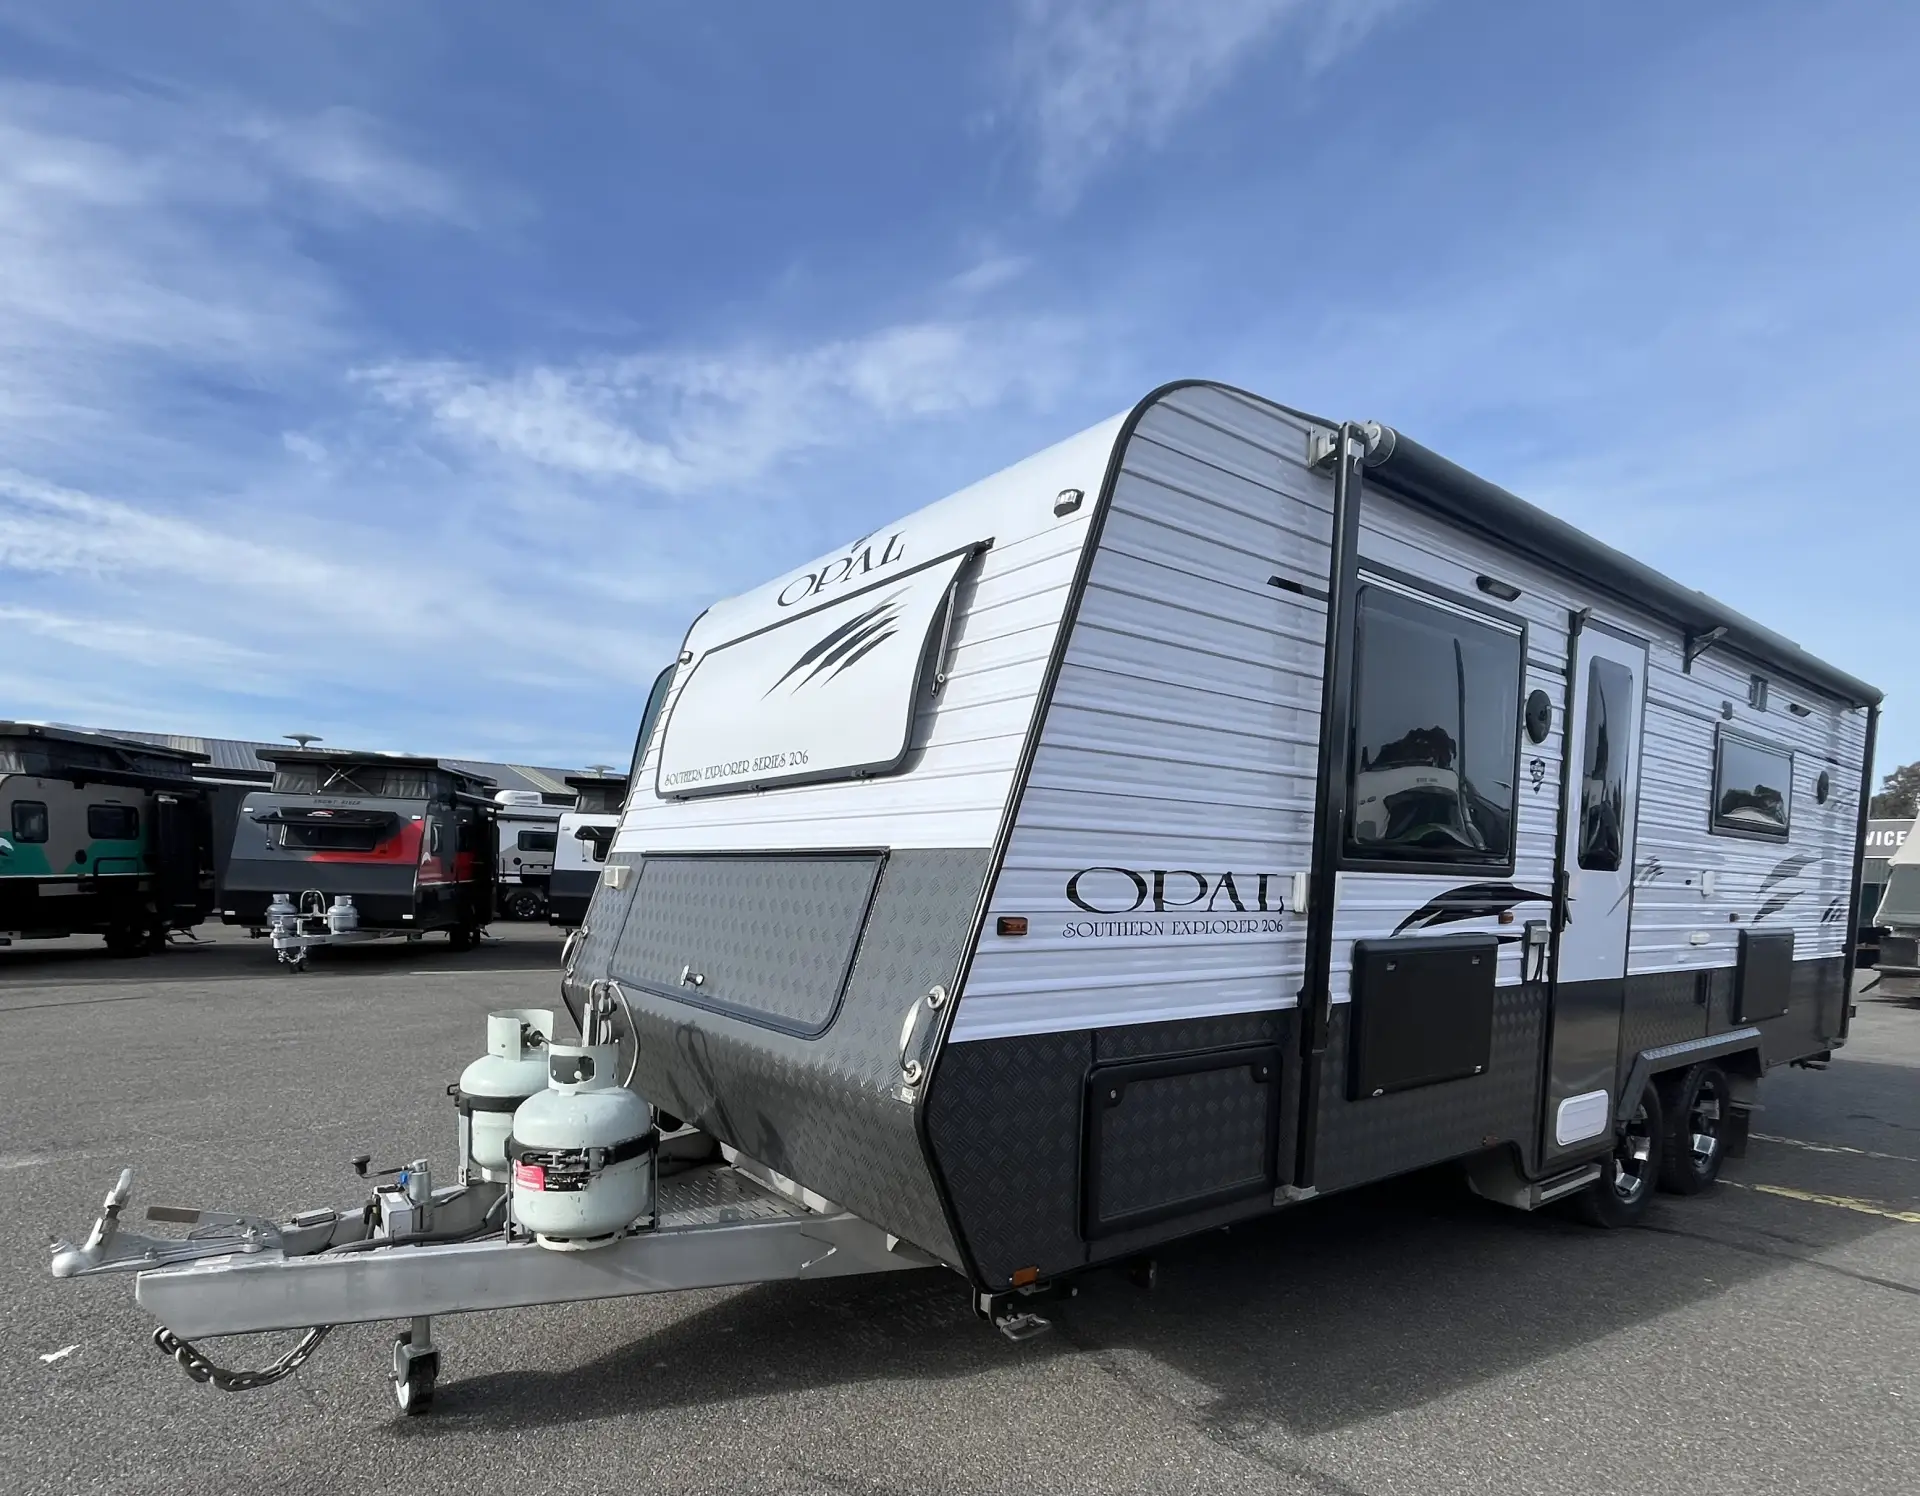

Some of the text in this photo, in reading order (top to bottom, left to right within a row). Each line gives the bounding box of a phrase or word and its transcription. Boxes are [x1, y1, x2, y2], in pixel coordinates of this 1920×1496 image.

[777, 530, 906, 607] OPAL
[664, 750, 809, 787] SOUTHERN EXPLORER SERIES 206
[1066, 866, 1284, 914] OPAL
[1062, 919, 1284, 938] SOUTHERN EXPLORER 206
